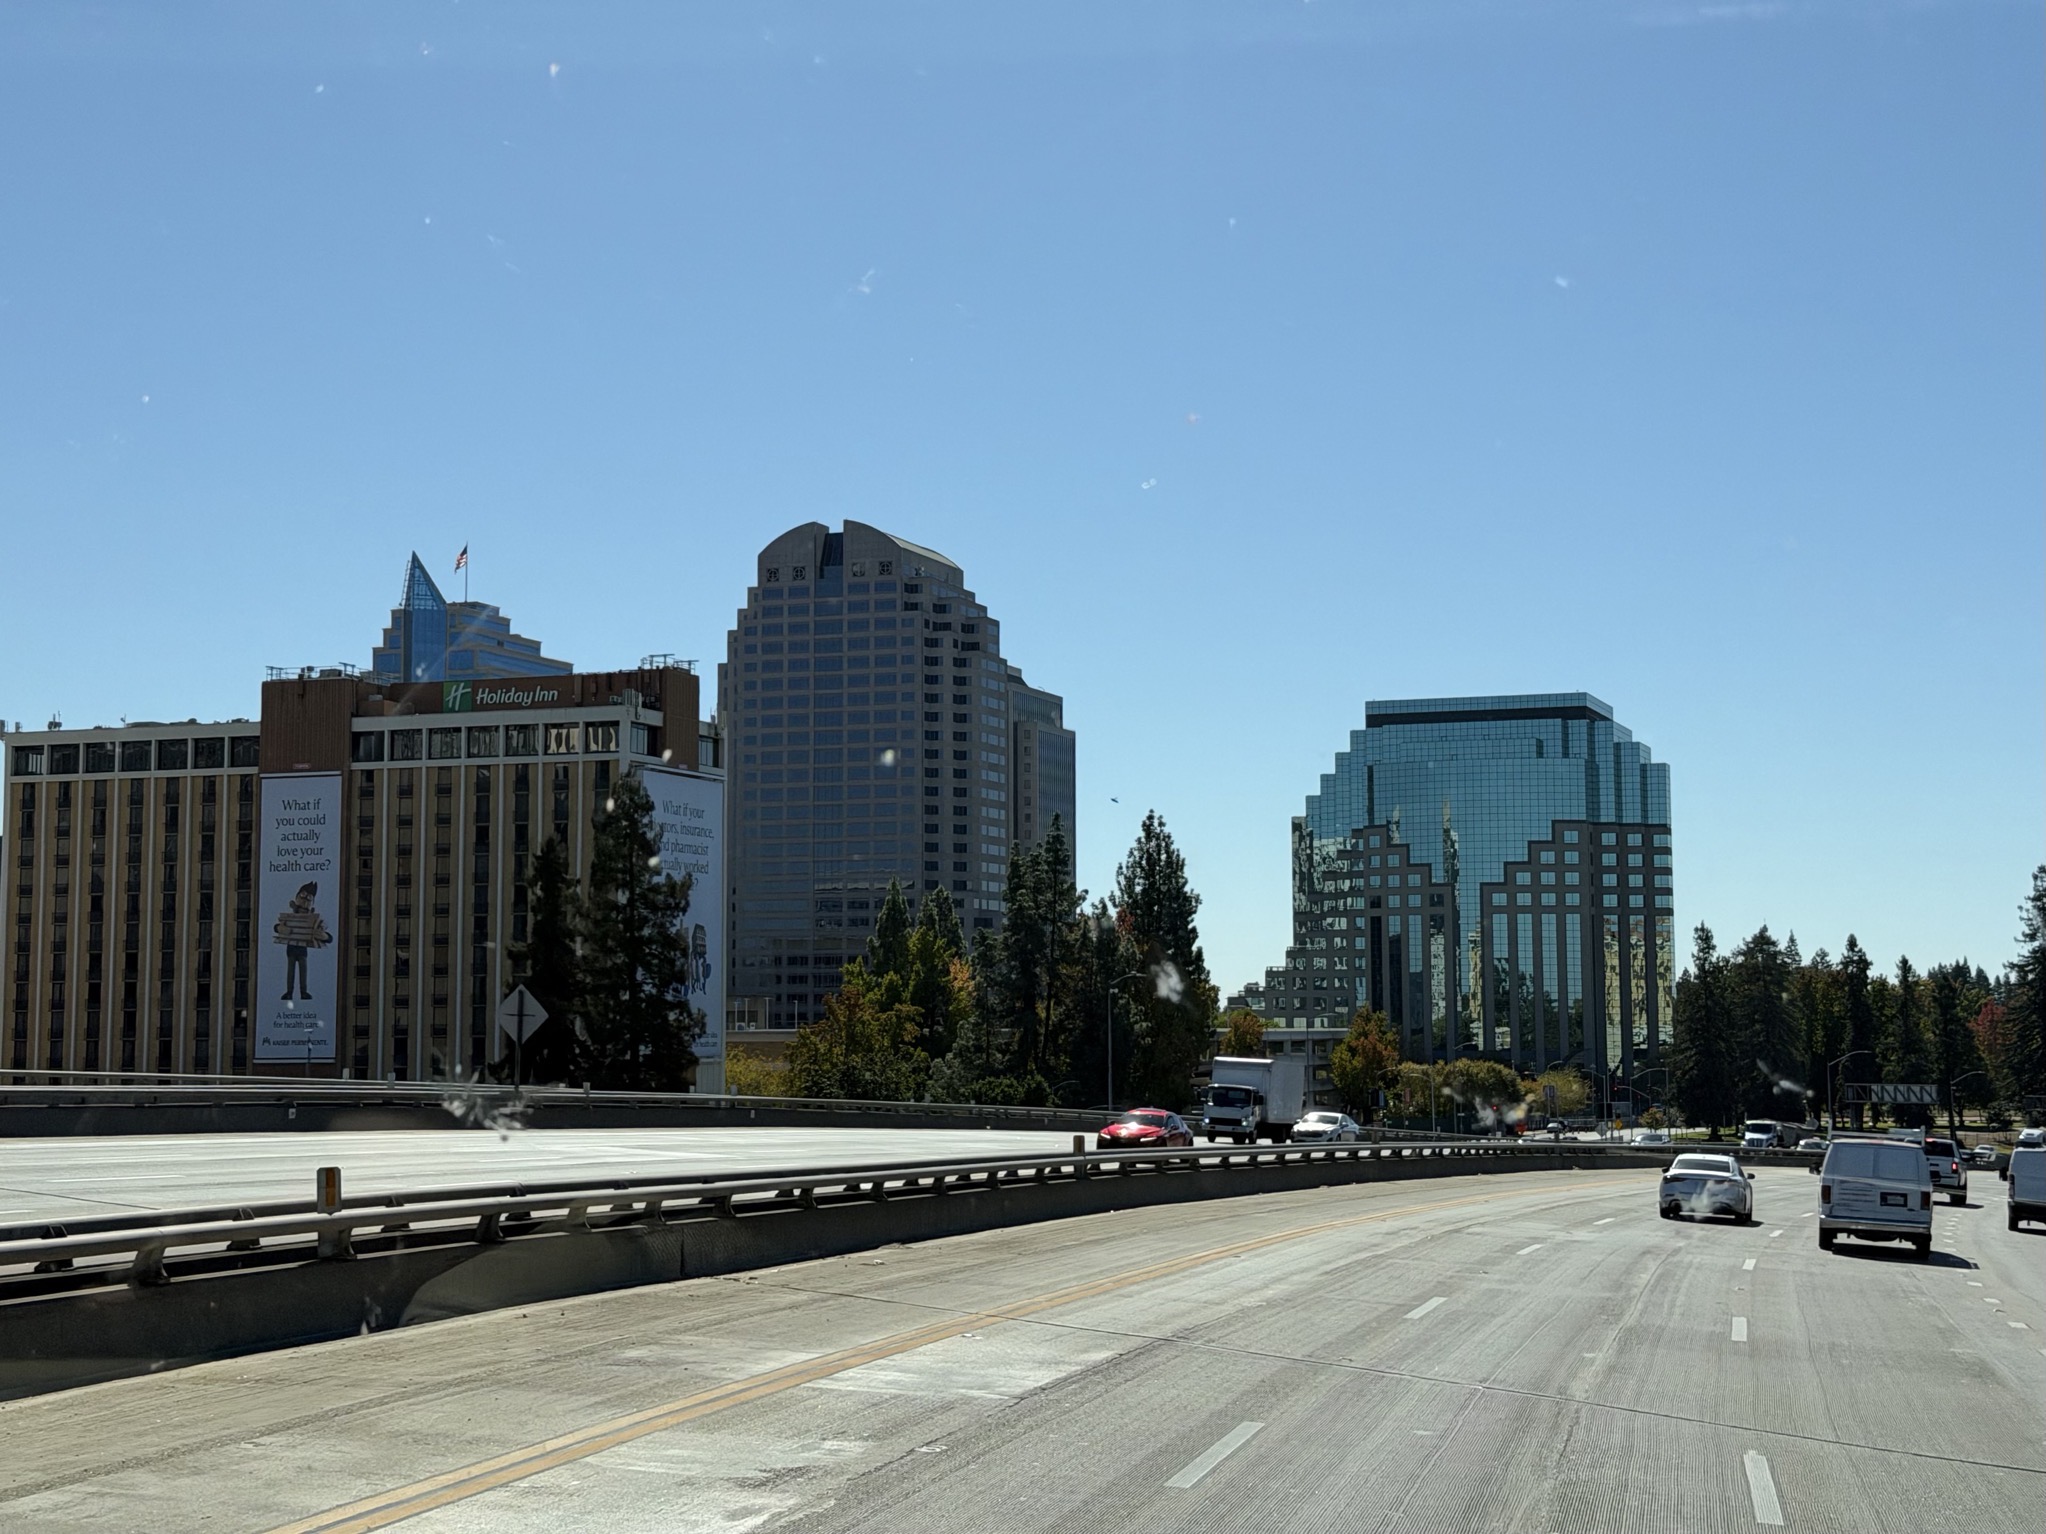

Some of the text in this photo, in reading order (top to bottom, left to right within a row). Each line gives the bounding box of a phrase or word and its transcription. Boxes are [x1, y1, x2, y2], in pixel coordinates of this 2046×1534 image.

[476, 686, 558, 706] Holiday Inn
[282, 798, 321, 811] What if
[663, 800, 705, 821] What if your
[275, 814, 326, 829] you could
[280, 829, 320, 843] actually
[680, 821, 714, 840] insurance,
[277, 845, 324, 859] love your
[671, 838, 709, 856] pharmacist
[269, 859, 331, 872] health care?
[684, 859, 709, 875] worked
[283, 1011, 302, 1020] better
[303, 1011, 317, 1020] idea
[273, 1020, 284, 1029] for
[284, 1020, 304, 1029] health
